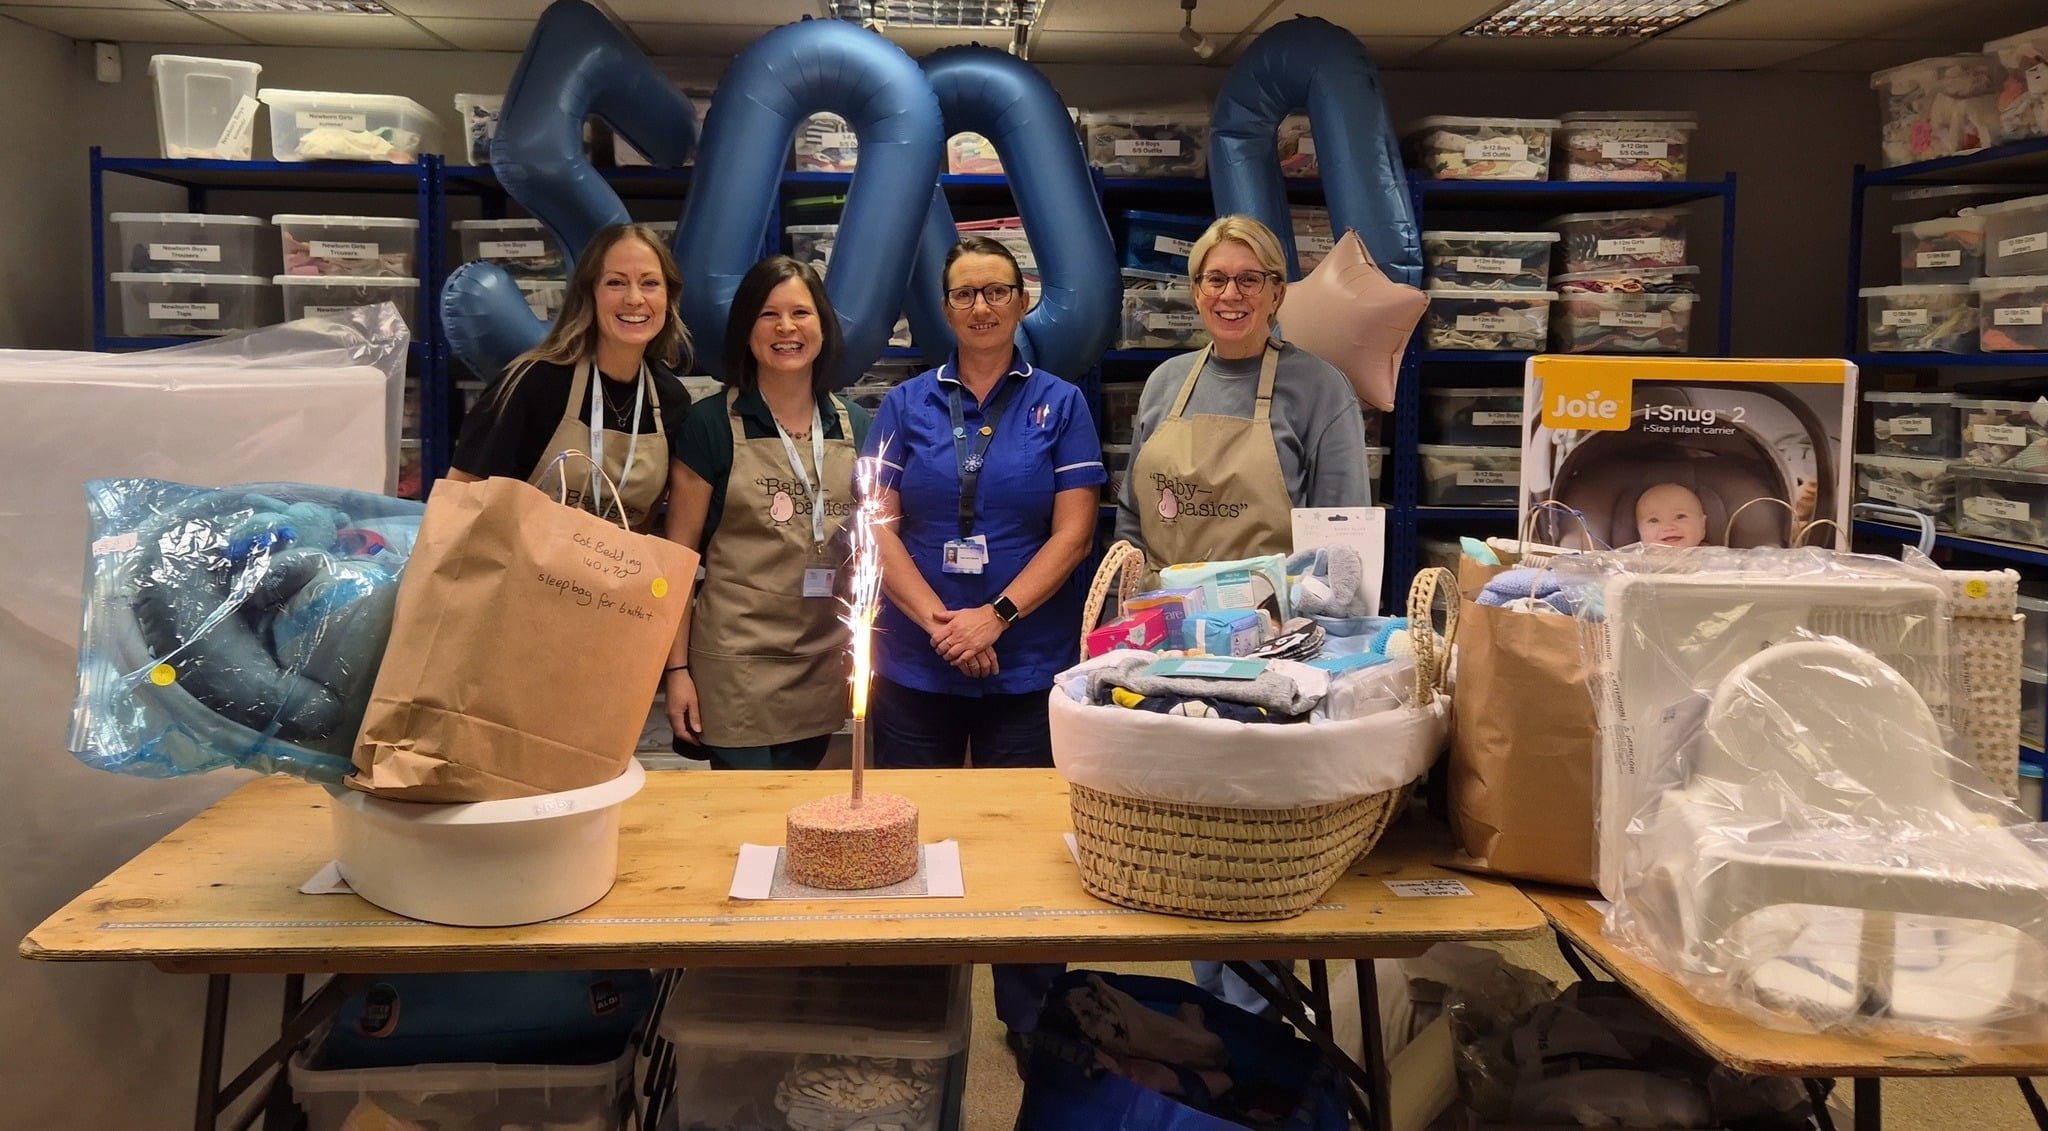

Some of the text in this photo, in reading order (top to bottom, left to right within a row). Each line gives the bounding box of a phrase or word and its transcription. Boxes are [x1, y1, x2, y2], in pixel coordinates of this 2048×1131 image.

[1551, 390, 1618, 419] Joie
[1731, 406, 1746, 423] 2
[1642, 423, 1736, 435] i-Size infant carrier
[573, 533, 592, 548] Cot
[583, 557, 602, 570] 140
[597, 593, 616, 609] for
[597, 996, 618, 1009] ALDI
